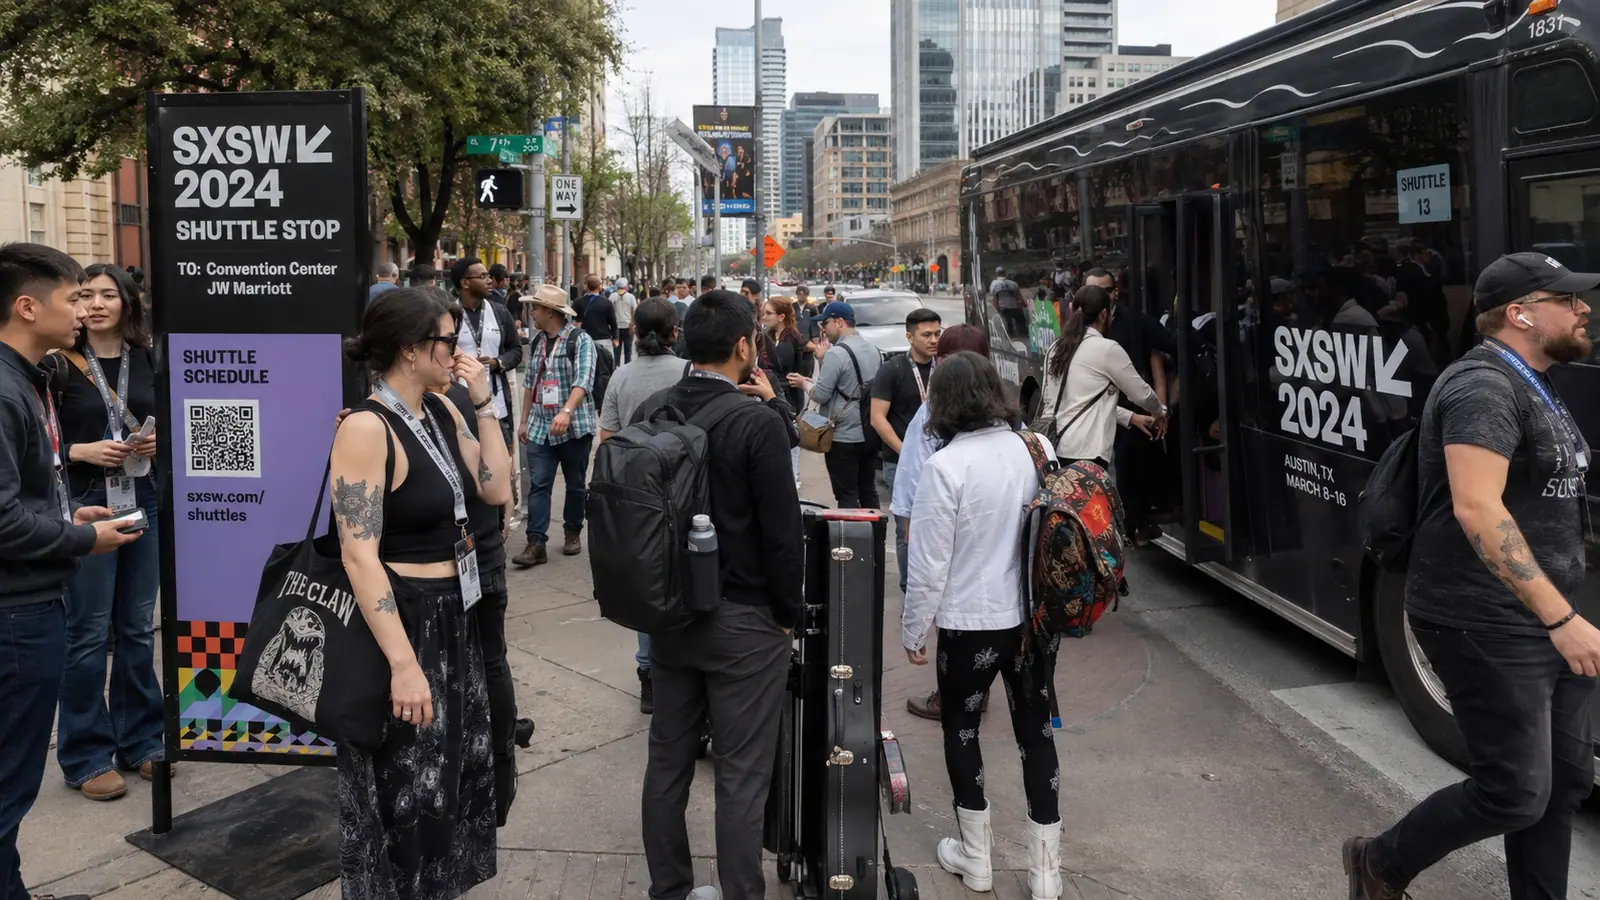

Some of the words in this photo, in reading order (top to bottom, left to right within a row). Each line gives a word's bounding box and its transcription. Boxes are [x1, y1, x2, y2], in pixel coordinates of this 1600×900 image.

[1528, 14, 1564, 39] 1831
[173, 125, 291, 165] SXSW
[174, 169, 284, 208] 2024
[556, 179, 577, 190] ONE
[1401, 173, 1446, 192] SHUTTLE
[556, 191, 577, 202] WAY
[1416, 198, 1431, 216] 13
[176, 220, 278, 240] SHUTTLE
[282, 219, 341, 240] STOP
[177, 262, 201, 275] TO:
[206, 262, 286, 276] Convention
[289, 261, 338, 276] Center
[207, 281, 230, 295] JW
[233, 281, 292, 295] Marriott
[183, 350, 256, 364] SHUTTLE
[1274, 325, 1368, 390] SXSW
[183, 369, 269, 384] SCHEDULE
[1278, 382, 1368, 452] 2024
[1284, 454, 1321, 480] AUSTIN,
[1320, 465, 1335, 483] TX
[1286, 472, 1321, 498] MARCH
[187, 490, 265, 505] sxsw.com/
[187, 508, 247, 522] shuttles
[277, 570, 308, 599] THE
[307, 582, 357, 627] CLAW
